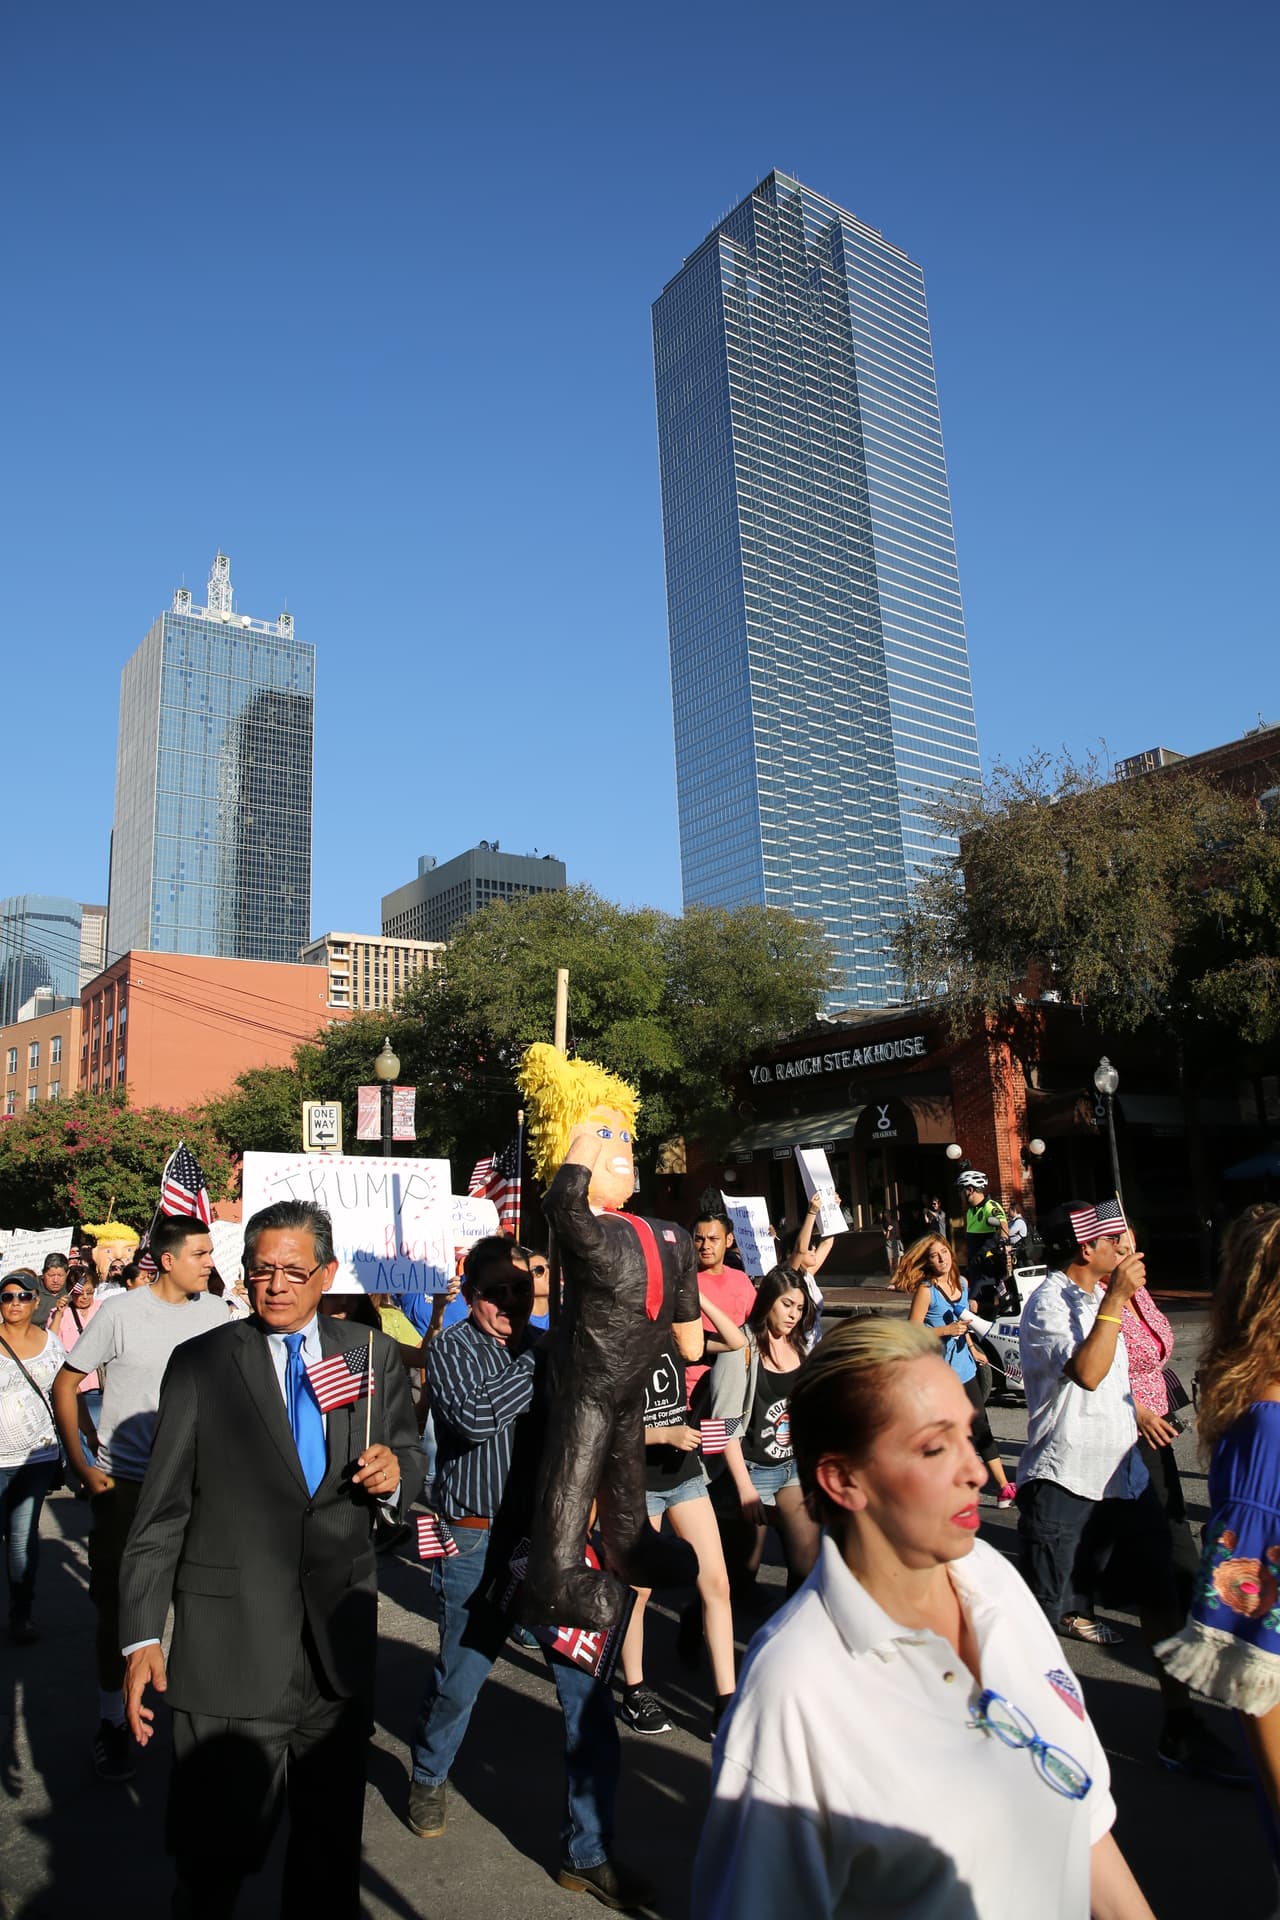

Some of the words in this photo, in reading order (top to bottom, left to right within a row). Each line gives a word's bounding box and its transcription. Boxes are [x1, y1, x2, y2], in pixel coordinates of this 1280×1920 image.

[775, 1056, 822, 1081] RANCH
[824, 1036, 926, 1071] STEAKHOUSE
[314, 1109, 335, 1119] ONE
[314, 1120, 336, 1129] WAY
[271, 1168, 431, 1215] TRUMP
[384, 1223, 447, 1263] Racist
[375, 1262, 449, 1291] AGAIN
[653, 1368, 669, 1393] C
[670, 1416, 683, 1424] with
[768, 1402, 787, 1419] ROL
